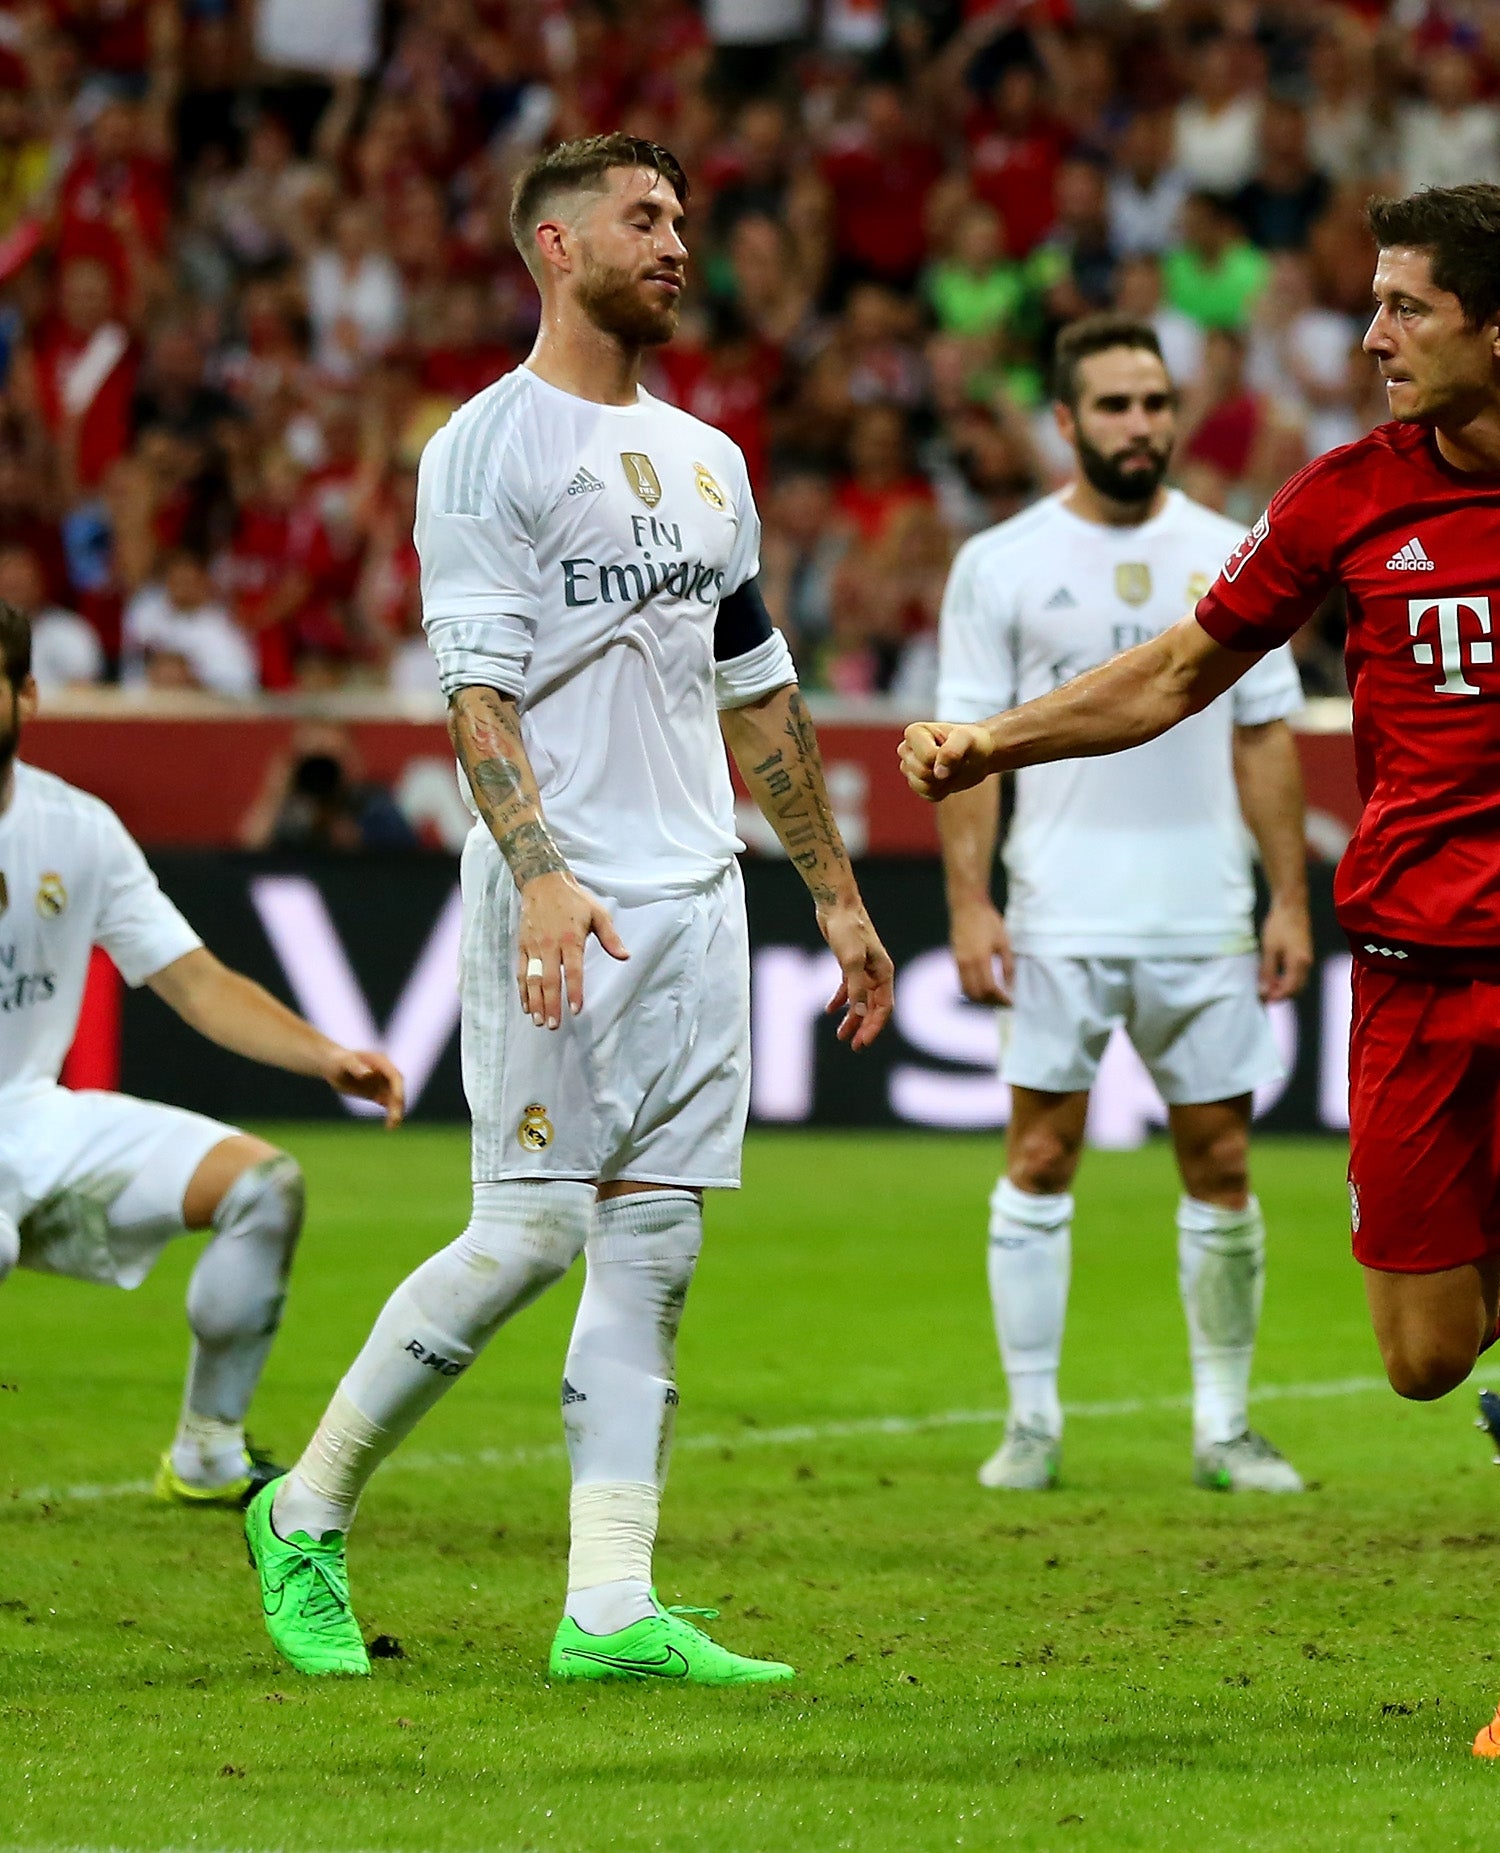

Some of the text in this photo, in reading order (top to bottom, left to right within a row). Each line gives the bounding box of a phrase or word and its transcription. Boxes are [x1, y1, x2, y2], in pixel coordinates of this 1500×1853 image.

[631, 515, 682, 552] Fly
[560, 551, 726, 608] Emirates
[1386, 559, 1435, 571] adidas
